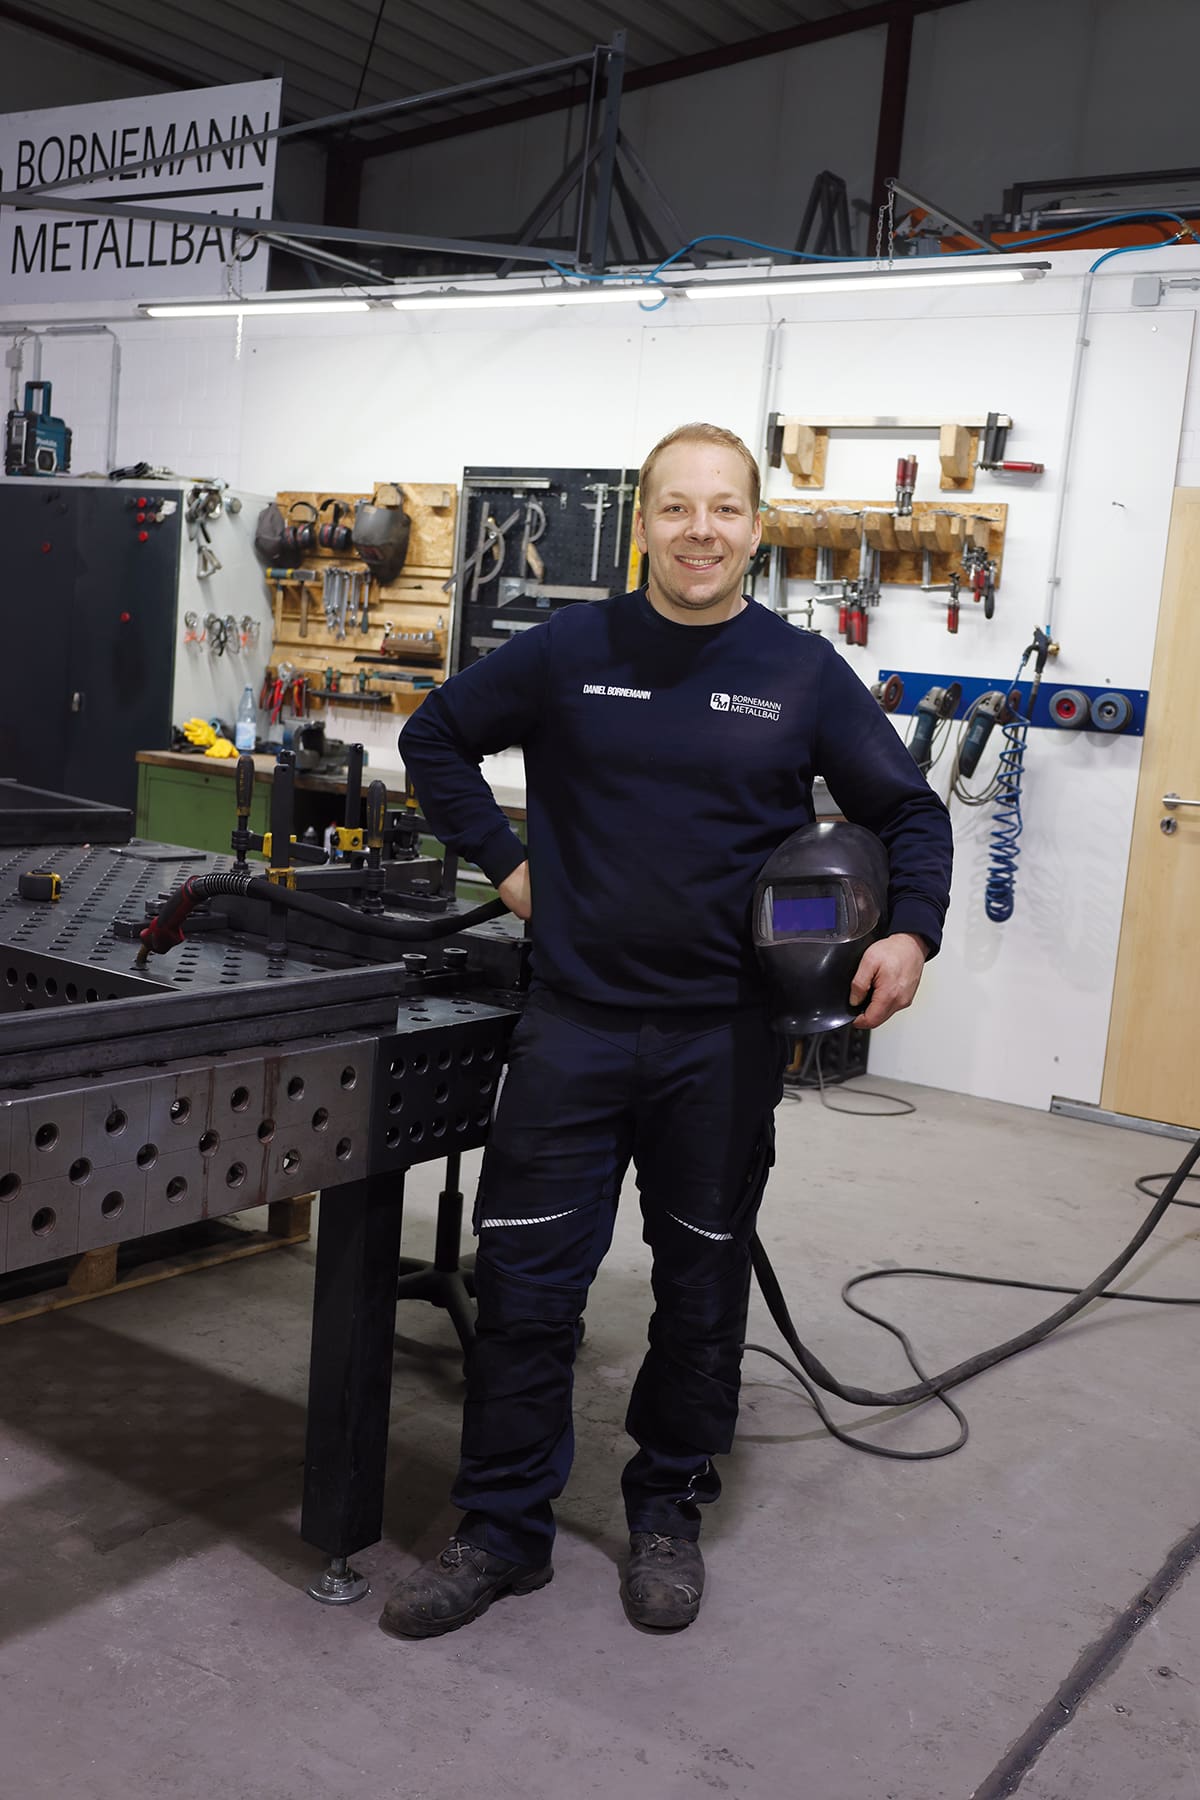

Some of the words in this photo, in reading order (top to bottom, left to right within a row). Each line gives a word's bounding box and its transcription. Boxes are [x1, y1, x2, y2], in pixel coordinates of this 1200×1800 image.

[16, 112, 270, 190] BORNEMANN
[11, 206, 262, 275] METALLBAU
[583, 684, 606, 695] DANIEL
[607, 686, 651, 700] BORNEMANN
[732, 695, 782, 711] BORNEMANN
[731, 705, 780, 721] METALLBAU
